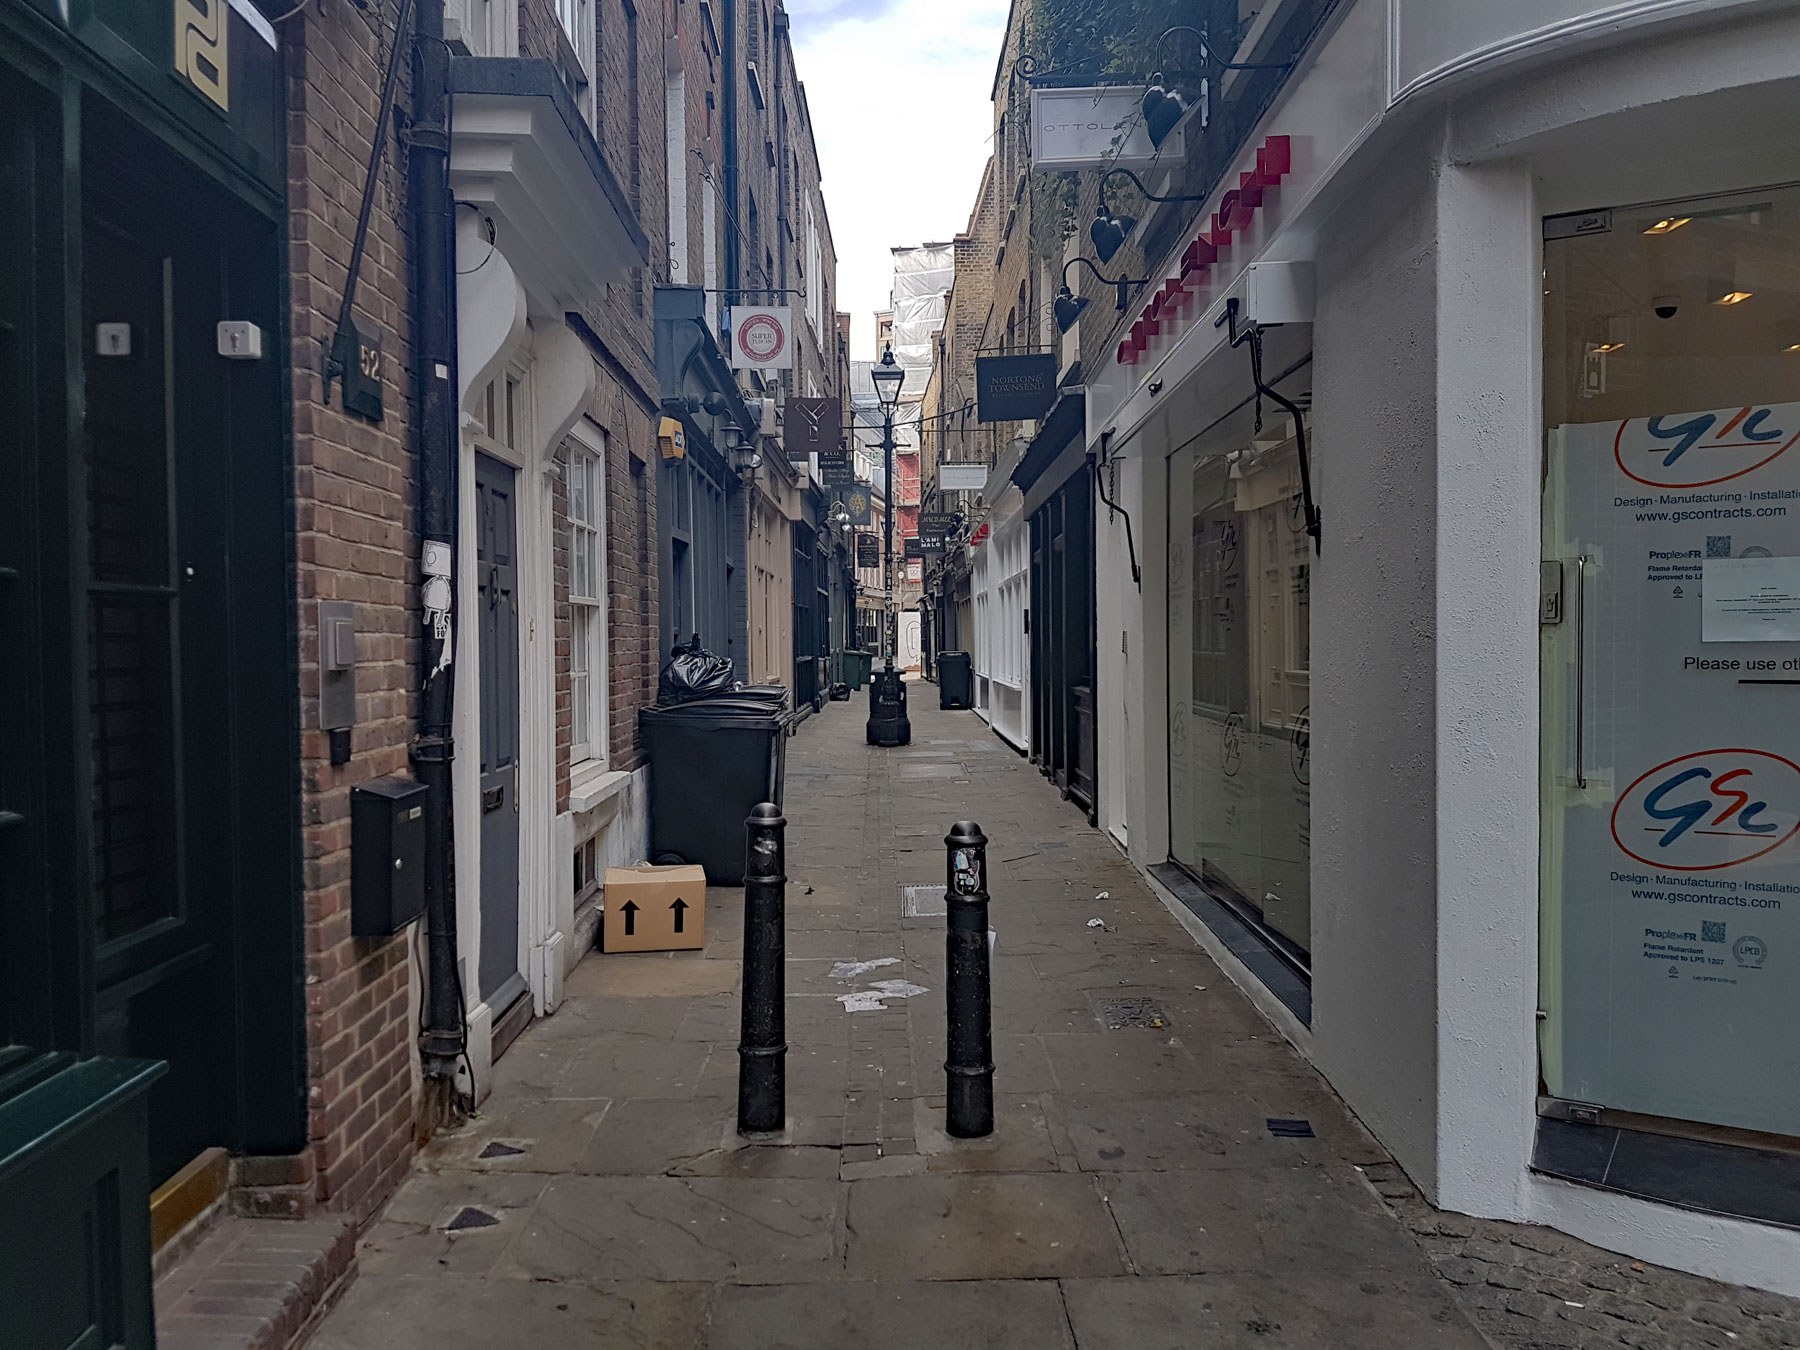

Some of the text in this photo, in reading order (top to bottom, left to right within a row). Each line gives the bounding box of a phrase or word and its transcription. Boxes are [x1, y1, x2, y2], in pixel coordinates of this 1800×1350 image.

[360, 345, 380, 382] 52
[989, 383, 1045, 393] TOWNSEND
[1613, 488, 1800, 508] Design Manufacturing Installati
[1635, 505, 1787, 524] www.gscontracts.com
[1684, 656, 1800, 671] Please use ot
[1609, 871, 1650, 885] Design
[1655, 875, 1737, 892] Manufacturing
[1631, 888, 1782, 910] www.gscontracts.com
[1643, 942, 1704, 954] Flame Retardant
[1740, 946, 1761, 956] LPCB
[1643, 951, 1679, 961] Approved
[1690, 955, 1705, 964] LPS
[1707, 957, 1725, 965] 1207
